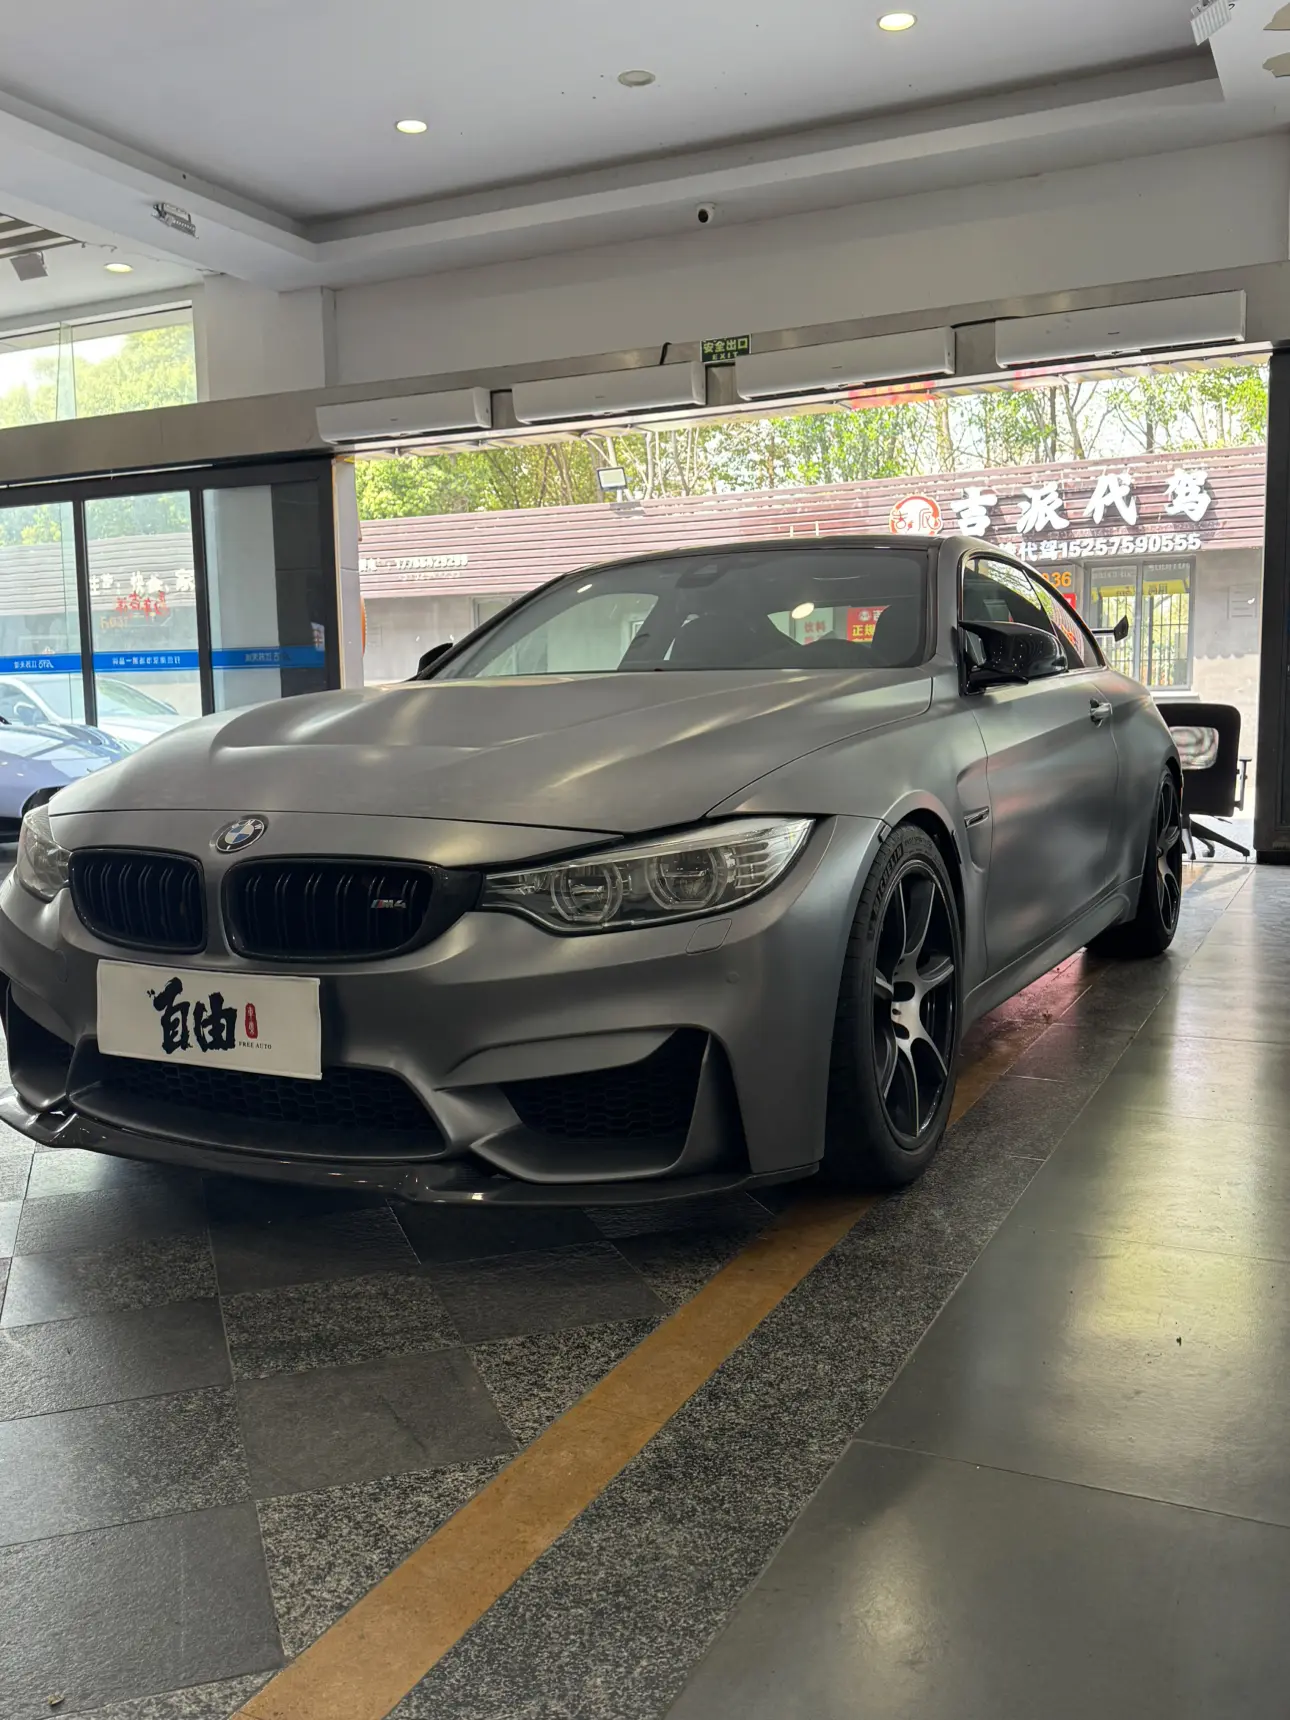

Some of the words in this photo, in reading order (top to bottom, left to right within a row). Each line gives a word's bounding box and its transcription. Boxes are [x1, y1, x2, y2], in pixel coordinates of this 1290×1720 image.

[703, 337, 748, 354] 安全出口
[712, 351, 738, 360] EXIT
[951, 468, 1213, 537] 吉派代驾
[872, 842, 904, 917] MICHELIN
[150, 976, 238, 1055] 自由
[238, 1041, 254, 1049] FREE
[255, 1042, 272, 1050] AUTO
